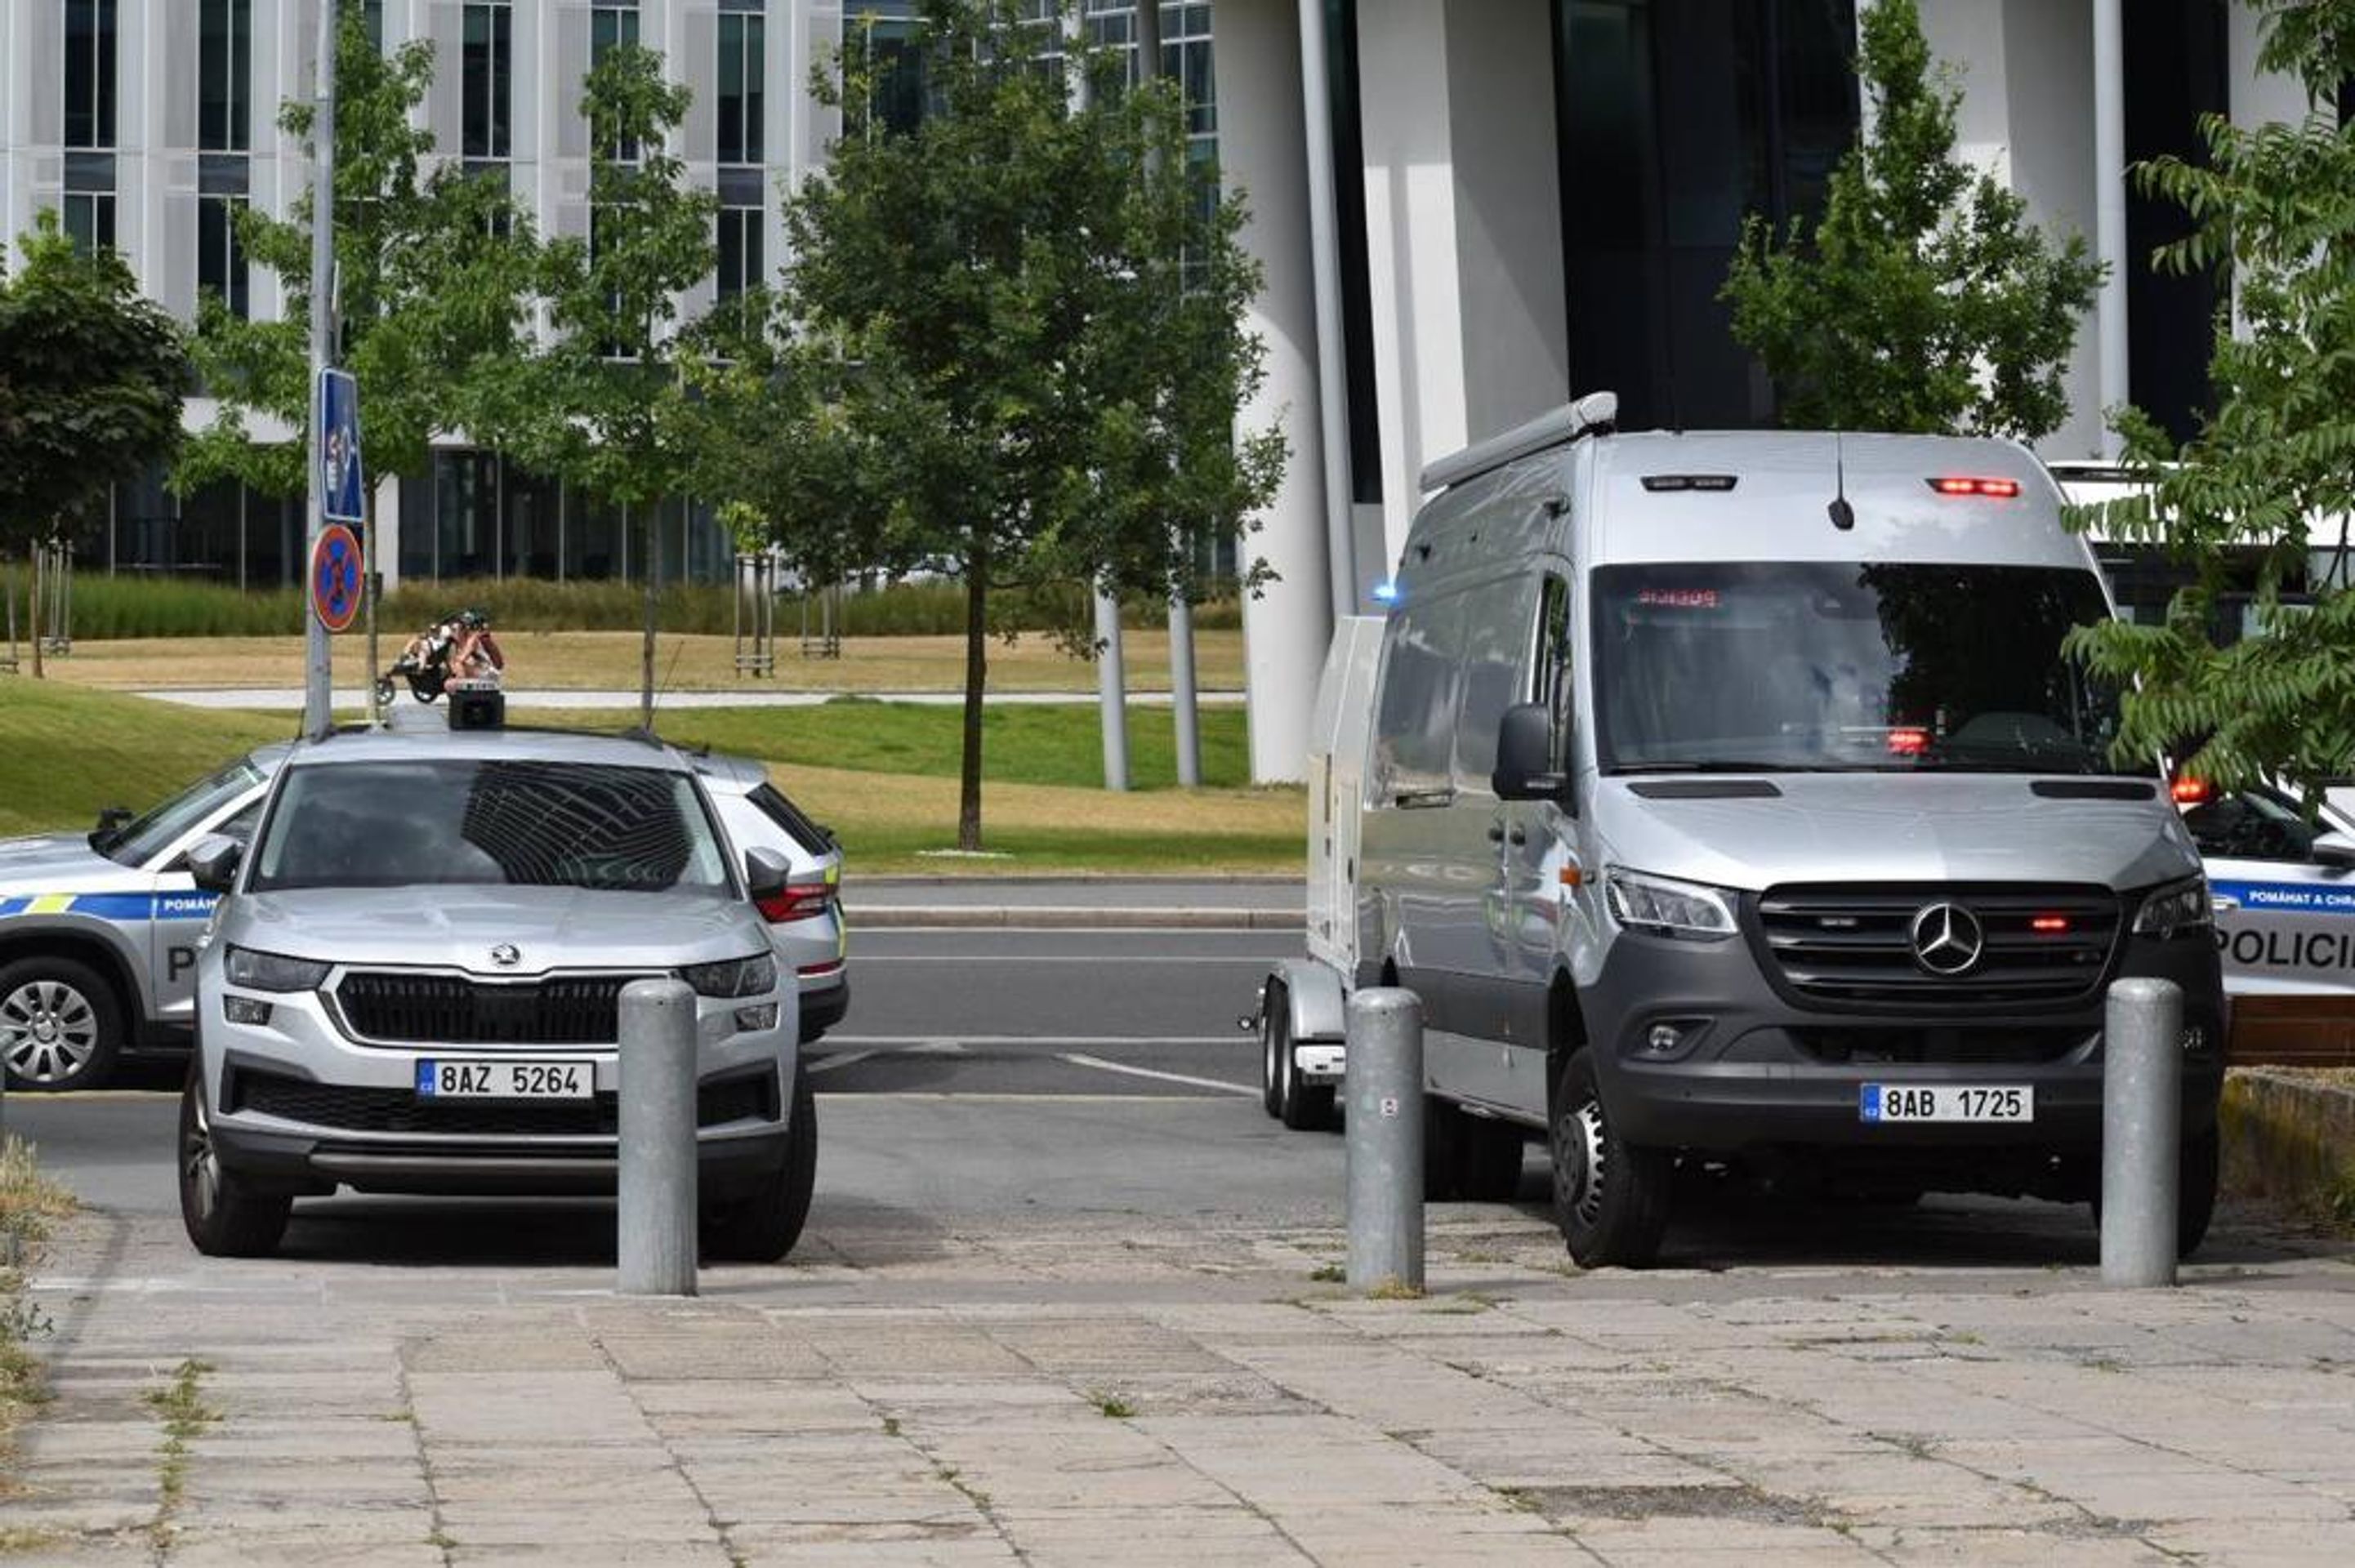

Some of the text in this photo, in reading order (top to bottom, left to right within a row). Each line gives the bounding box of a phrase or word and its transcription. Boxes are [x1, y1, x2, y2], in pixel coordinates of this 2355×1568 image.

[2313, 894, 2324, 905] A
[2216, 928, 2355, 969] POLICI
[441, 1066, 491, 1094] 8AZ
[512, 1066, 578, 1094] 5264
[1887, 1089, 2021, 1117] 8AB 1725
